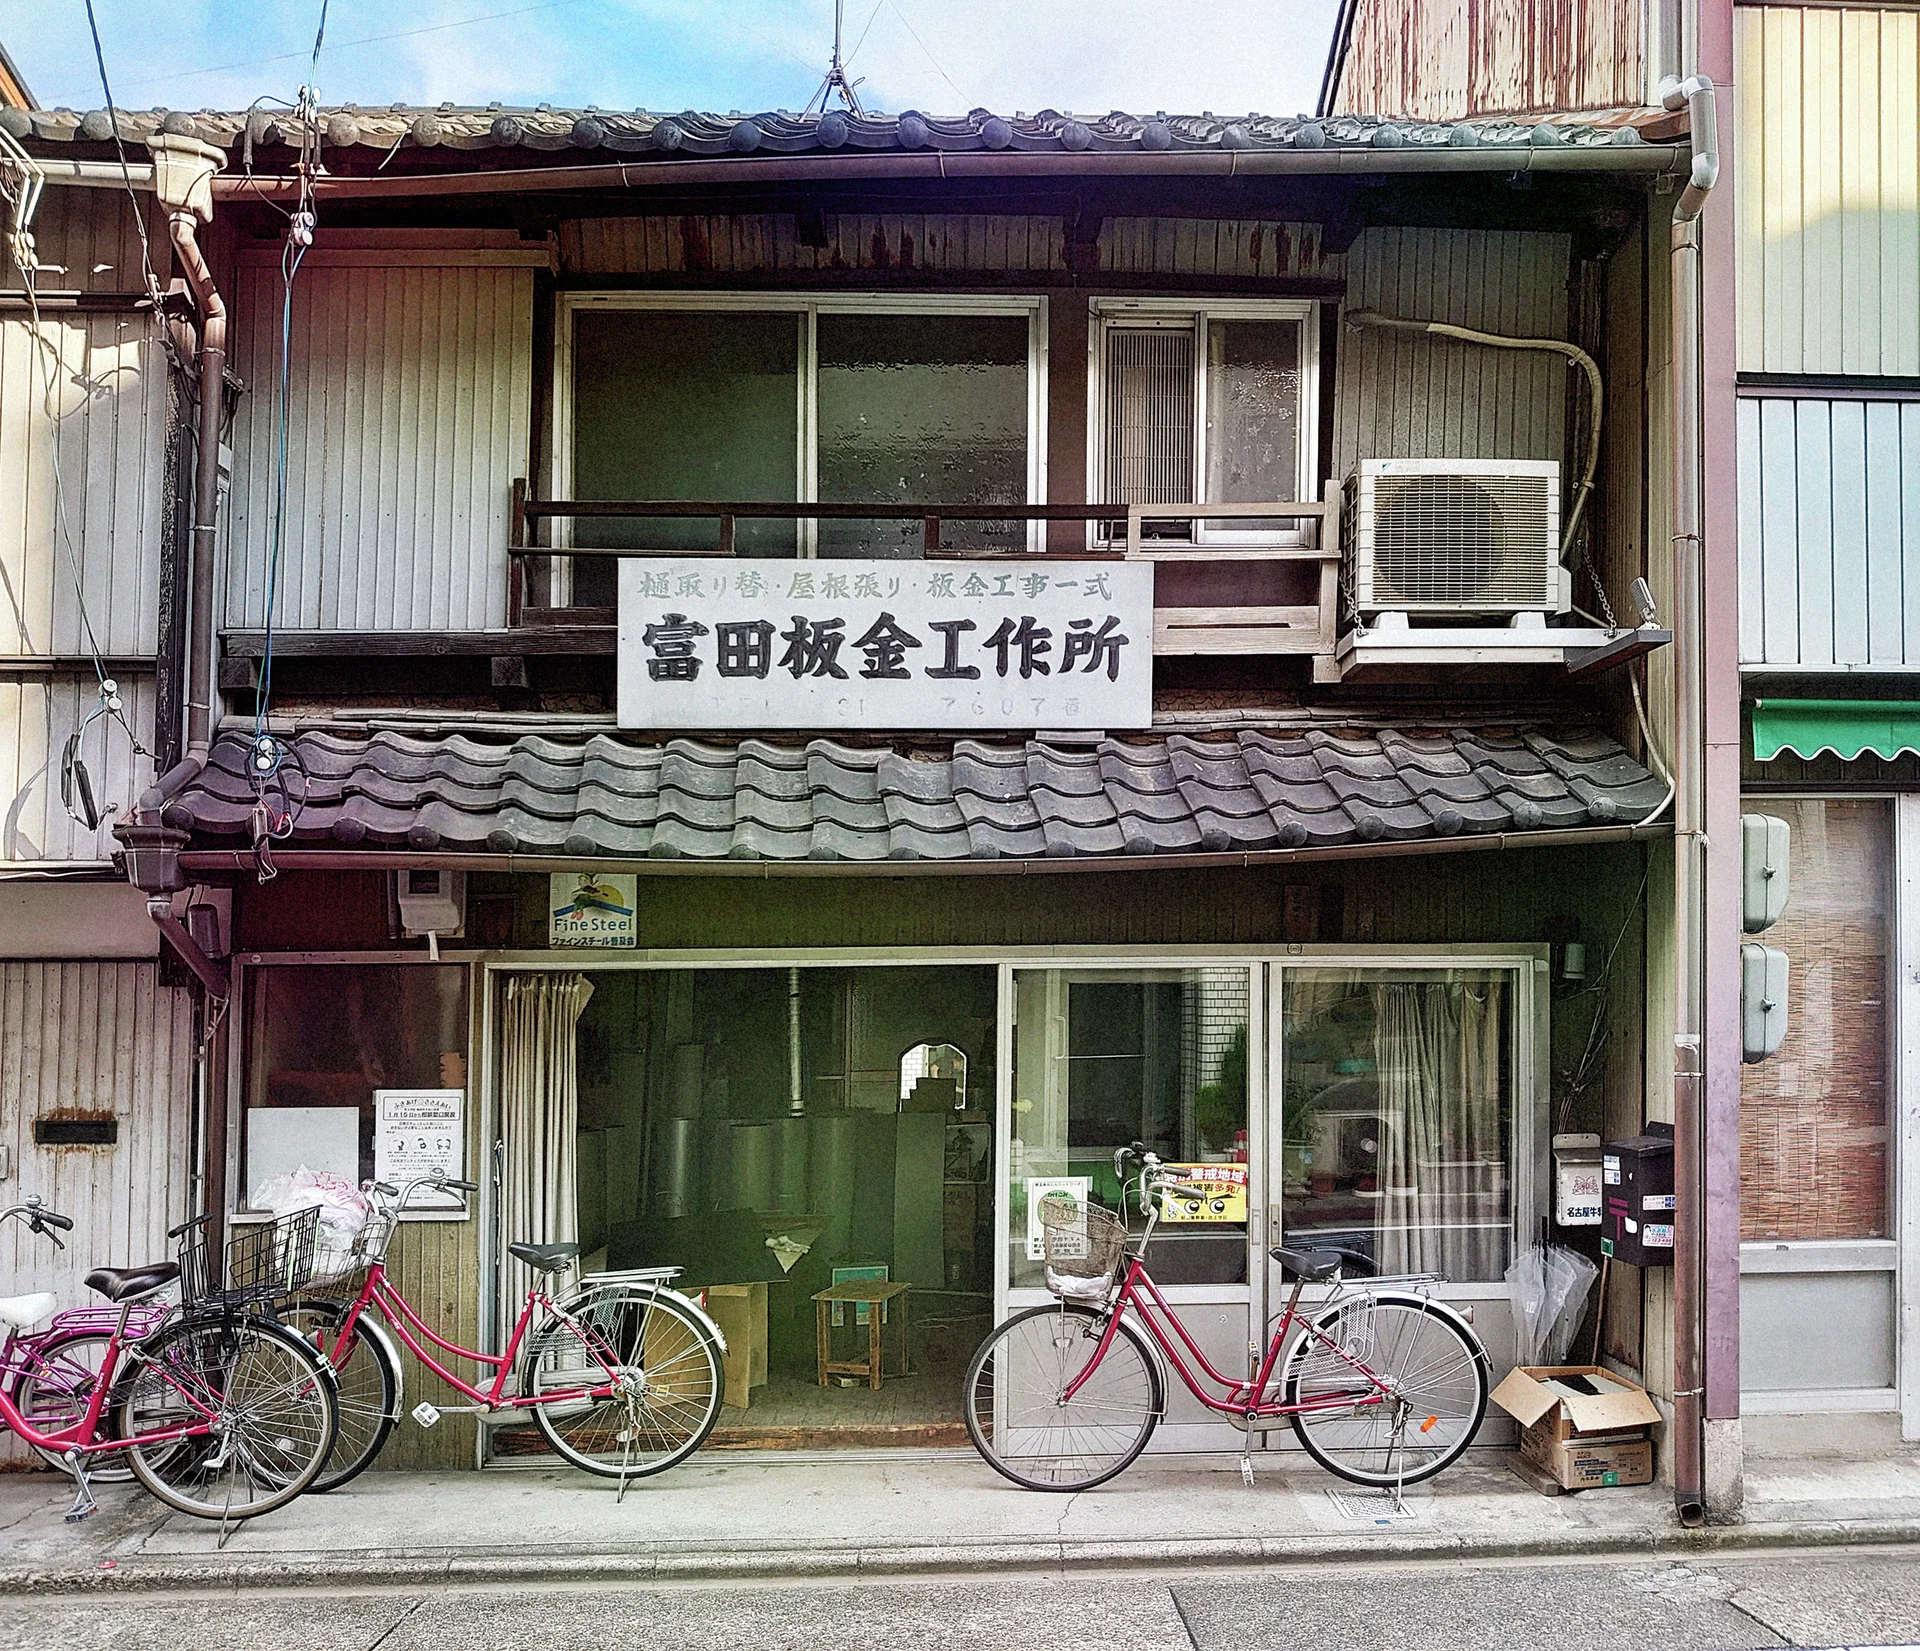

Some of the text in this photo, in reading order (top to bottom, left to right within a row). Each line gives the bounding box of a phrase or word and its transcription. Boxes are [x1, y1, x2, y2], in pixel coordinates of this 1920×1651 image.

[641, 611, 1131, 683] 富田板金工作所
